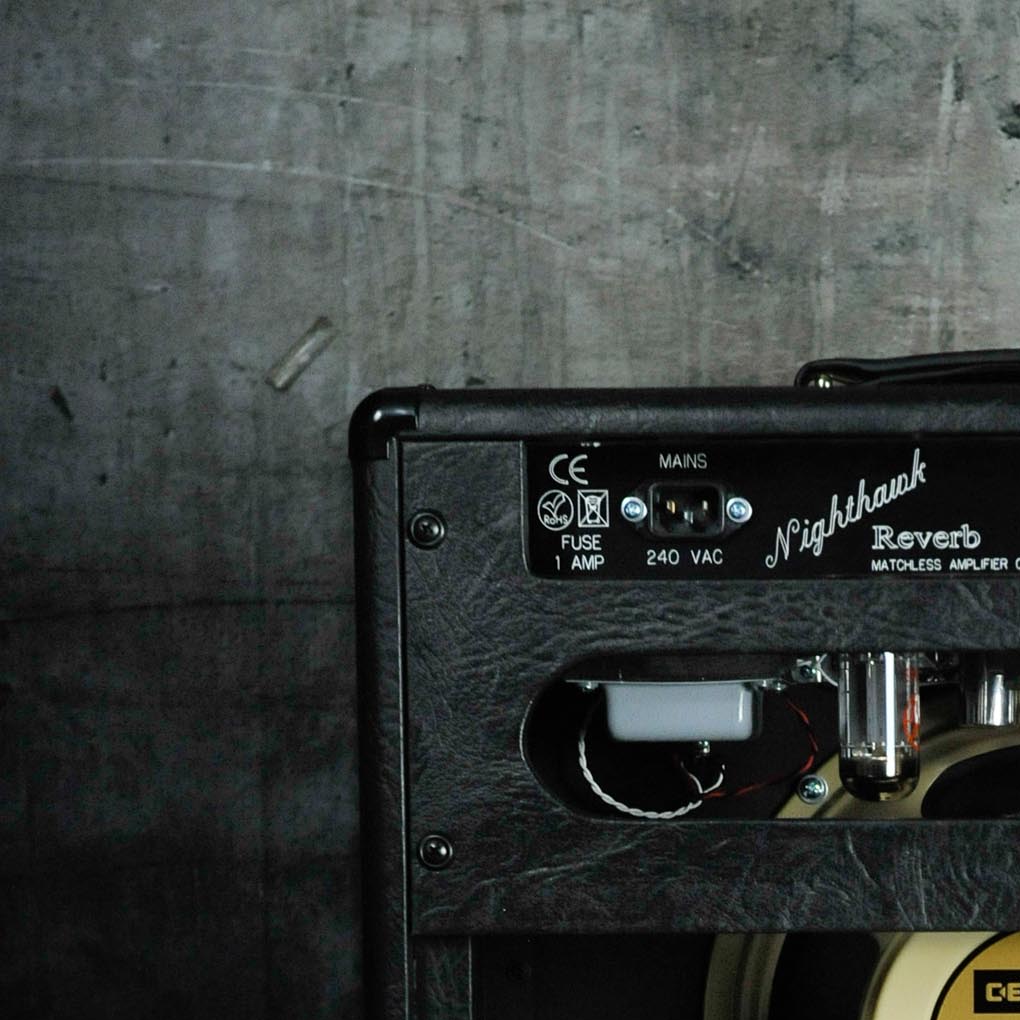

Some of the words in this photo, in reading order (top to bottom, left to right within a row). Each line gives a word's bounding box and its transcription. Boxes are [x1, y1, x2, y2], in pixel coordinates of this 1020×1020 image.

[659, 453, 708, 470] MAINS
[765, 448, 927, 569] Nighthawk
[543, 514, 568, 526] RoHS
[561, 534, 602, 551] FUSE
[871, 523, 982, 550] Reverb
[554, 555, 561, 571] 1
[571, 553, 605, 571] AMP
[646, 549, 680, 566] 240
[690, 548, 724, 566] VAC
[871, 558, 942, 572] MATCHLESS
[949, 557, 1009, 571] AMPLIFIER
